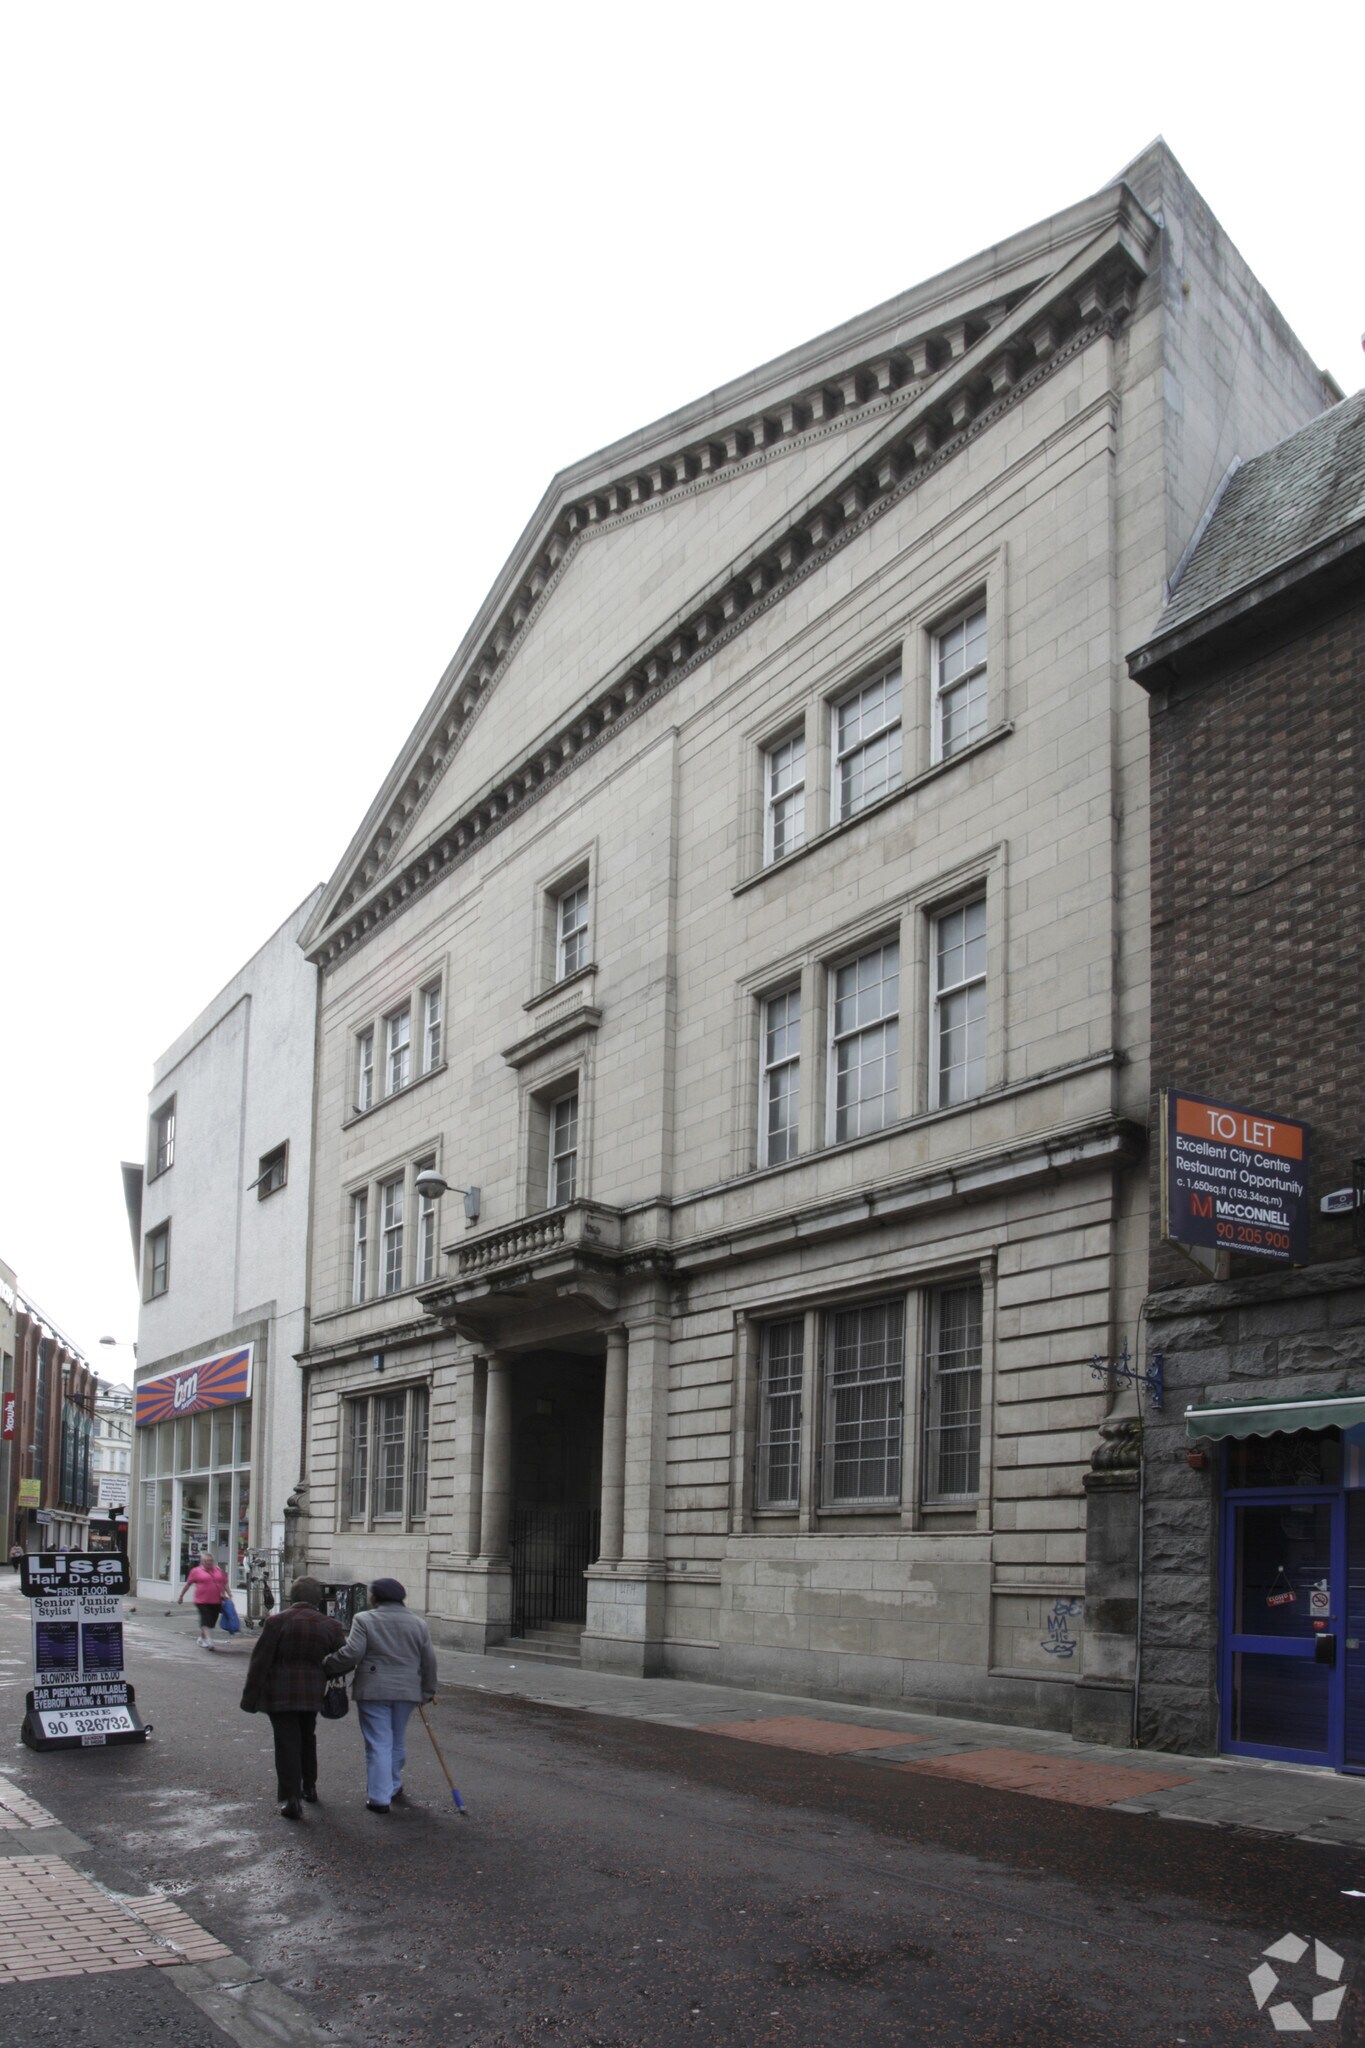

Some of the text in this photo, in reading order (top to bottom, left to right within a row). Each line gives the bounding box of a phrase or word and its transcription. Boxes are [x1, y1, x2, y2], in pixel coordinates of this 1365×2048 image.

[1207, 1110, 1275, 1148] TO LET
[1176, 1136, 1291, 1173] Excellent City Centre
[1176, 1156, 1303, 1197] Restaurant Opportunity
[1229, 1187, 1282, 1208] (153.34sq.m)
[1216, 1222, 1290, 1249] 90 205 900
[28, 1556, 123, 1573] Lisa
[29, 1574, 61, 1584] Hair
[57, 1586, 108, 1596] FIRST FLOOR
[35, 1597, 75, 1608] Senior
[80, 1597, 119, 1606] Junior
[38, 1607, 72, 1617] Stylist
[84, 1606, 116, 1615] Stylist
[41, 1672, 79, 1684] BLOWDRYS
[82, 1673, 98, 1681] from
[34, 1684, 127, 1700] EAR PIERCING AVAILABLE
[34, 1694, 127, 1710] EYEBROW WAXING & TINTING
[59, 1709, 111, 1718] PHONE
[48, 1716, 130, 1735] 90 326732
